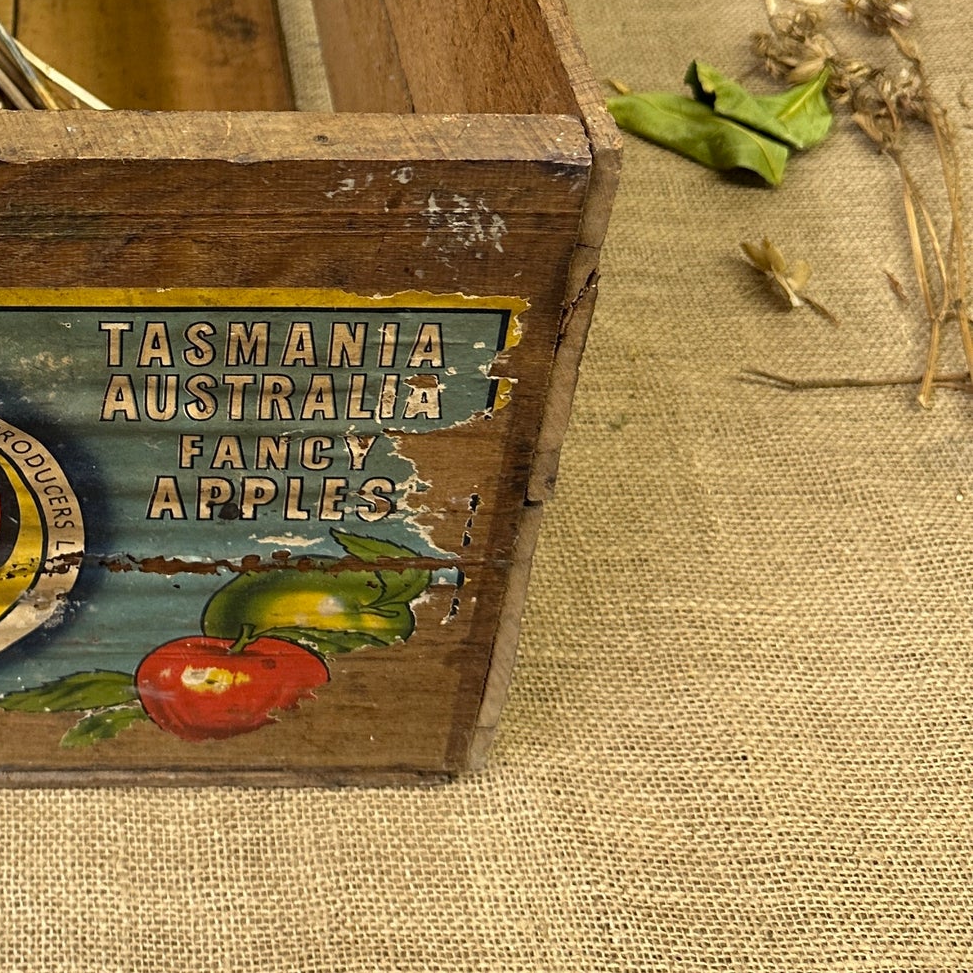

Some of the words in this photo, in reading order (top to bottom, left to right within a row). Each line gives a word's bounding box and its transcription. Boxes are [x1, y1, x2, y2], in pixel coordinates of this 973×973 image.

[98, 320, 445, 369] TASMANIA
[99, 373, 443, 422] AUSTRALIA
[179, 434, 380, 471] FANCY
[146, 475, 397, 522] APPLES
